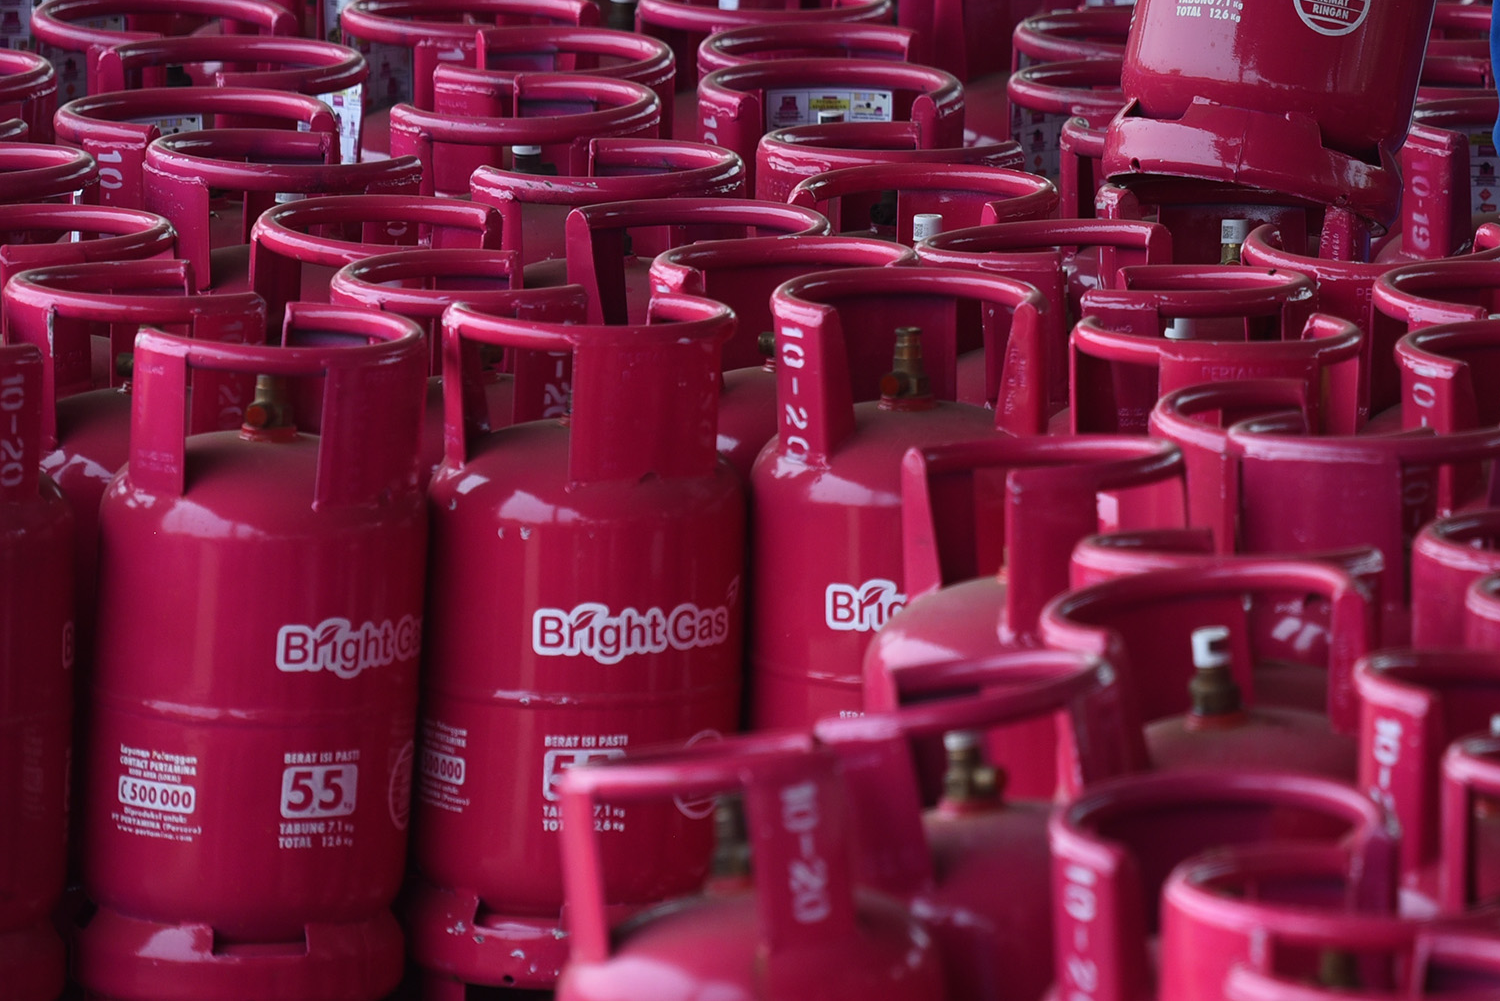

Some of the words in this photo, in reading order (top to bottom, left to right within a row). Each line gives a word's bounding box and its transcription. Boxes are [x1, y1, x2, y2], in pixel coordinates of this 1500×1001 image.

[1176, 5, 1202, 17] TOTAL
[1312, 3, 1350, 20] RINGAN
[781, 325, 809, 465] 10-20
[0, 372, 25, 487] 10-20
[536, 607, 664, 662] Bright
[670, 606, 727, 648] Gas
[280, 621, 392, 675] Bright
[544, 735, 580, 747] BERAT
[581, 735, 597, 747] ISI
[598, 734, 629, 747] PASTI
[284, 752, 318, 764] BERAT
[319, 752, 333, 763] ISI
[149, 760, 197, 776] PERTAMINA
[279, 822, 326, 835] TABUNG
[278, 836, 312, 849] TOTAL
